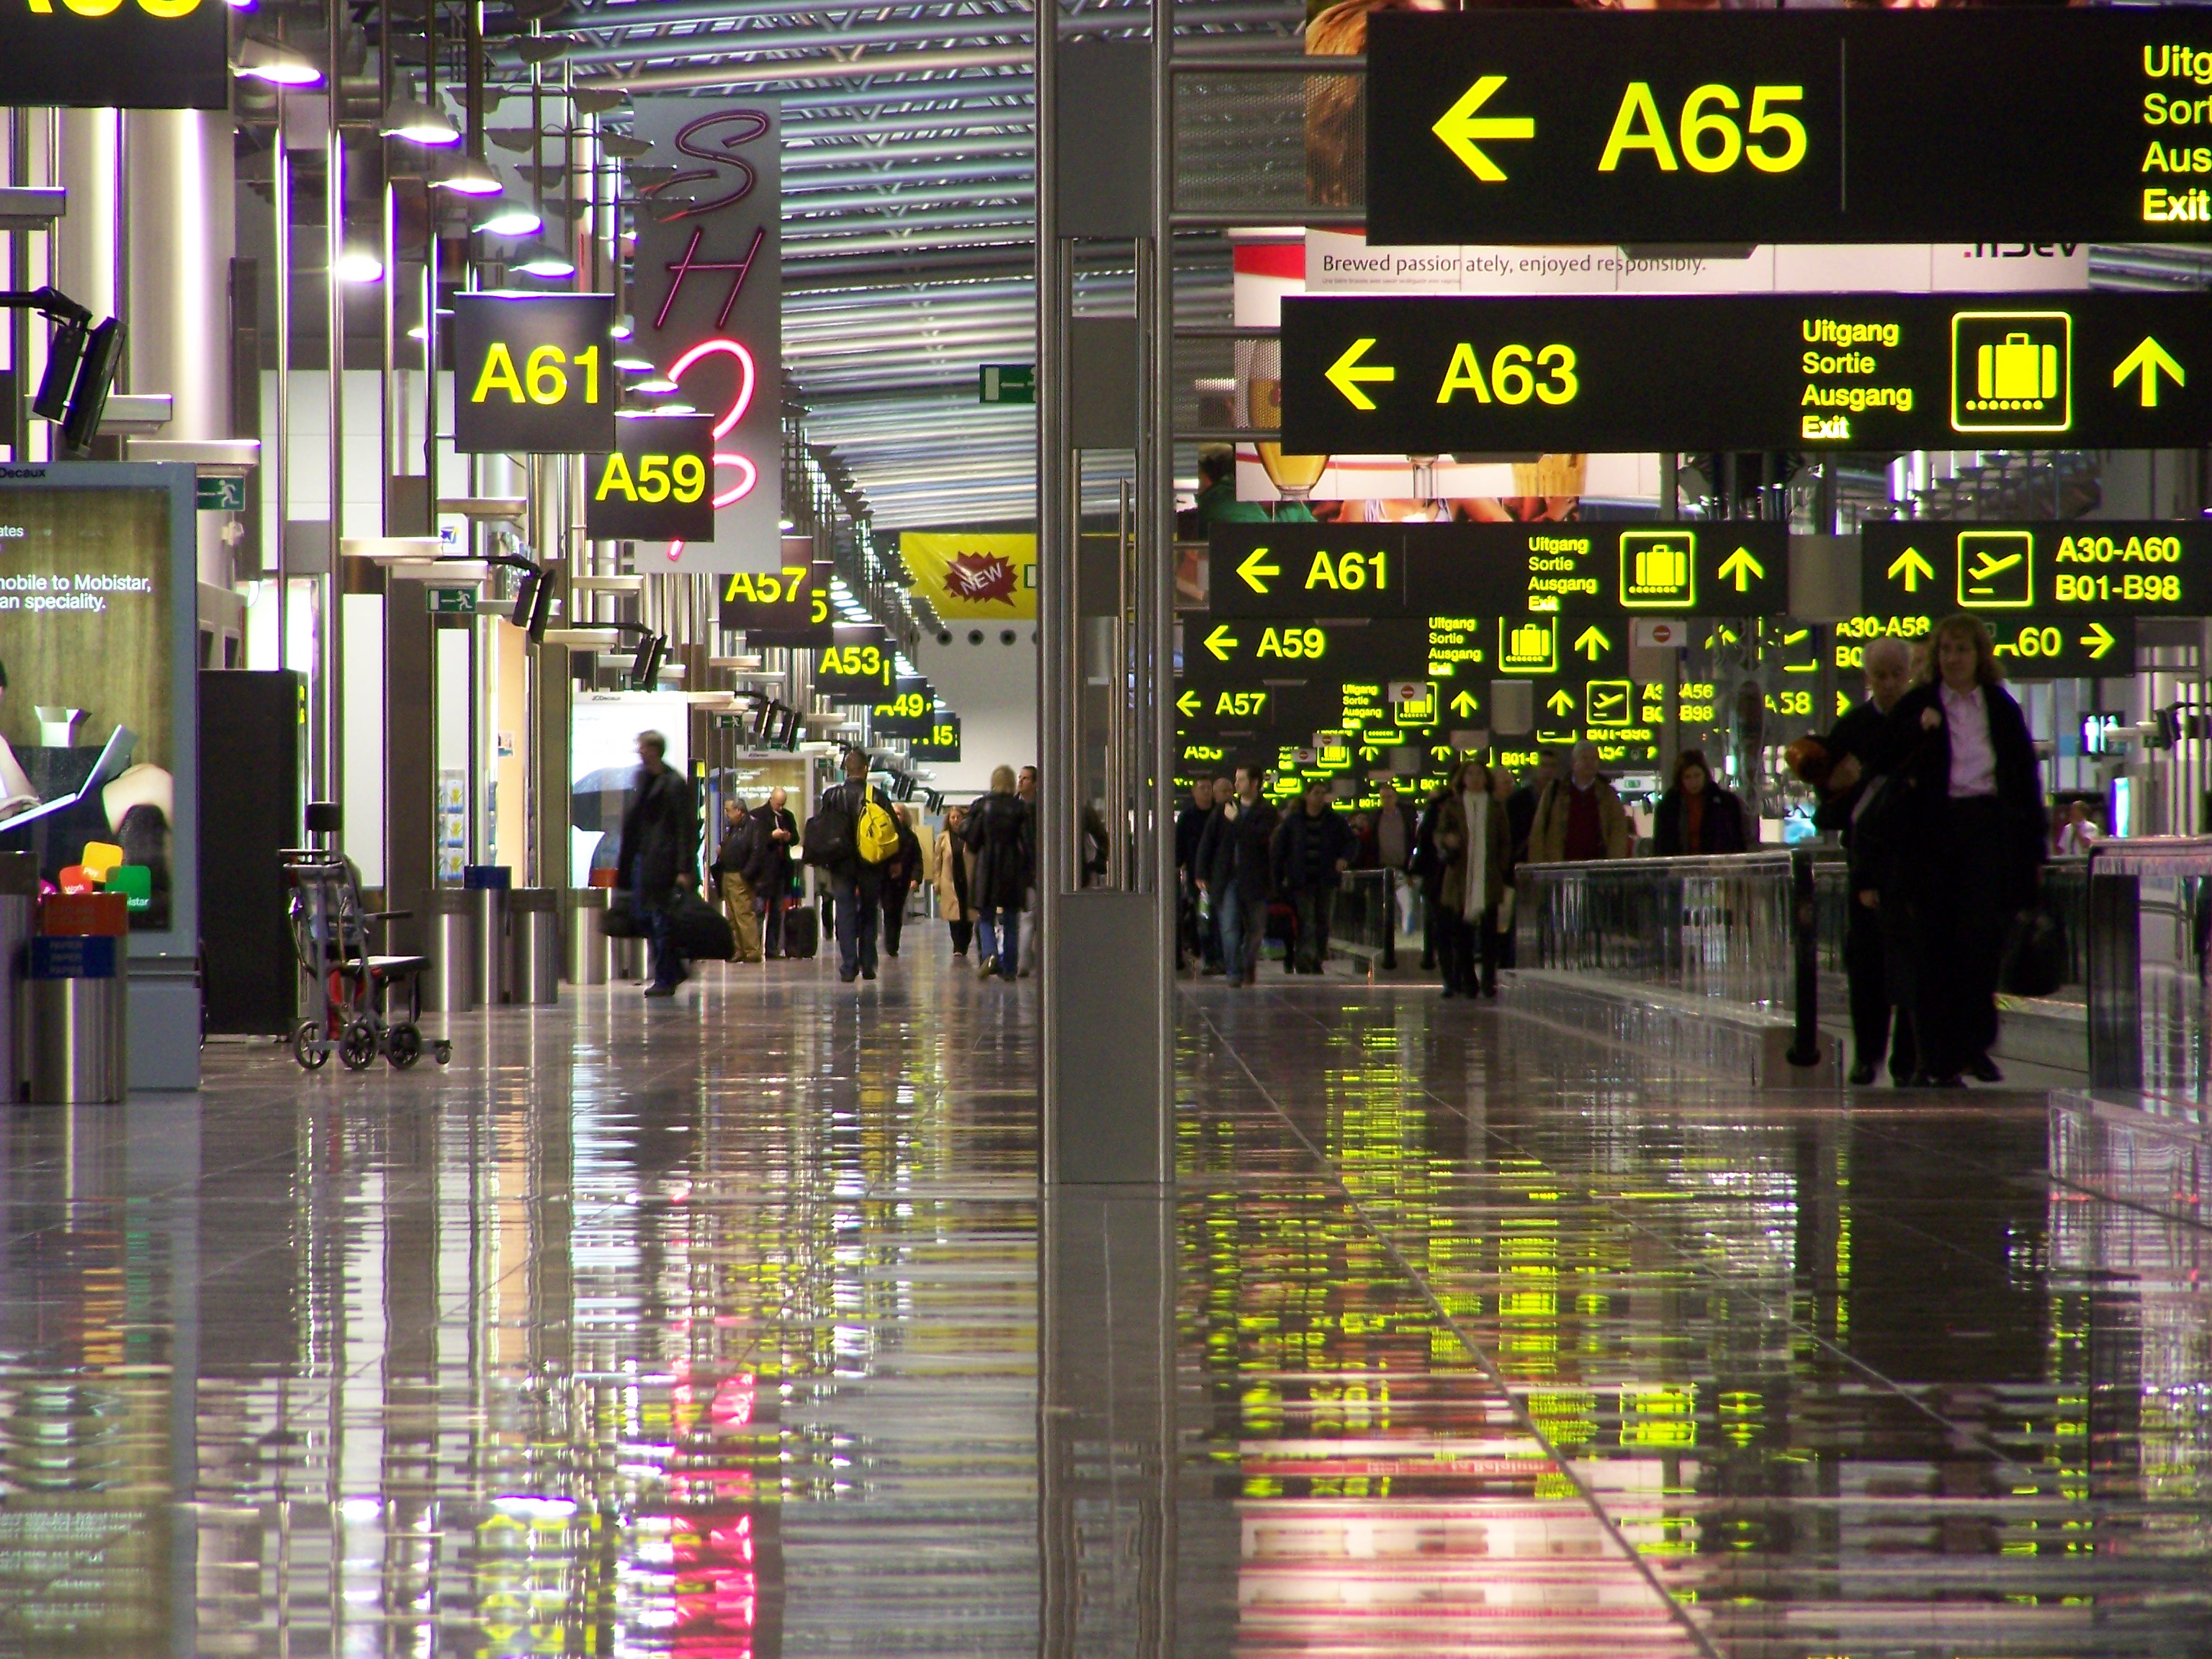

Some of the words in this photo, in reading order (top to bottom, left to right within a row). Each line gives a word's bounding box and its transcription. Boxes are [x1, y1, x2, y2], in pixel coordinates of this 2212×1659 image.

[1599, 83, 1806, 172] A65
[2142, 141, 2212, 173] Aus
[2143, 188, 2211, 221] Exit
[1323, 254, 1390, 271] Brewed
[1519, 254, 1591, 276] enjoyed
[1804, 320, 1898, 347] Uitgang
[472, 343, 598, 405] A61
[1437, 343, 1577, 405] A63
[1803, 352, 1874, 374] Sortie
[1802, 385, 1911, 411] Ausgang
[1802, 415, 1849, 439] Exit
[595, 451, 705, 503] A59
[1529, 536, 1588, 554] Uitgang
[2056, 536, 2180, 562] A30-A60
[1305, 552, 1384, 590] A61
[1529, 557, 1573, 570] Sortie
[52, 575, 70, 590] to
[74, 574, 151, 593] Mobistar,
[725, 566, 806, 603] A57
[960, 562, 1002, 596] NEW
[1529, 577, 1596, 594] Ausgang
[2056, 575, 2179, 601] B01-B98
[24, 593, 107, 612] speciality.
[1529, 595, 1558, 611] Exit
[1429, 617, 1475, 631] Uitgang
[1256, 628, 1324, 658] A59
[1429, 632, 1463, 644] Sortie
[819, 646, 880, 675] A53
[1429, 648, 1481, 662] Ausgang
[1215, 693, 1265, 715] A57
